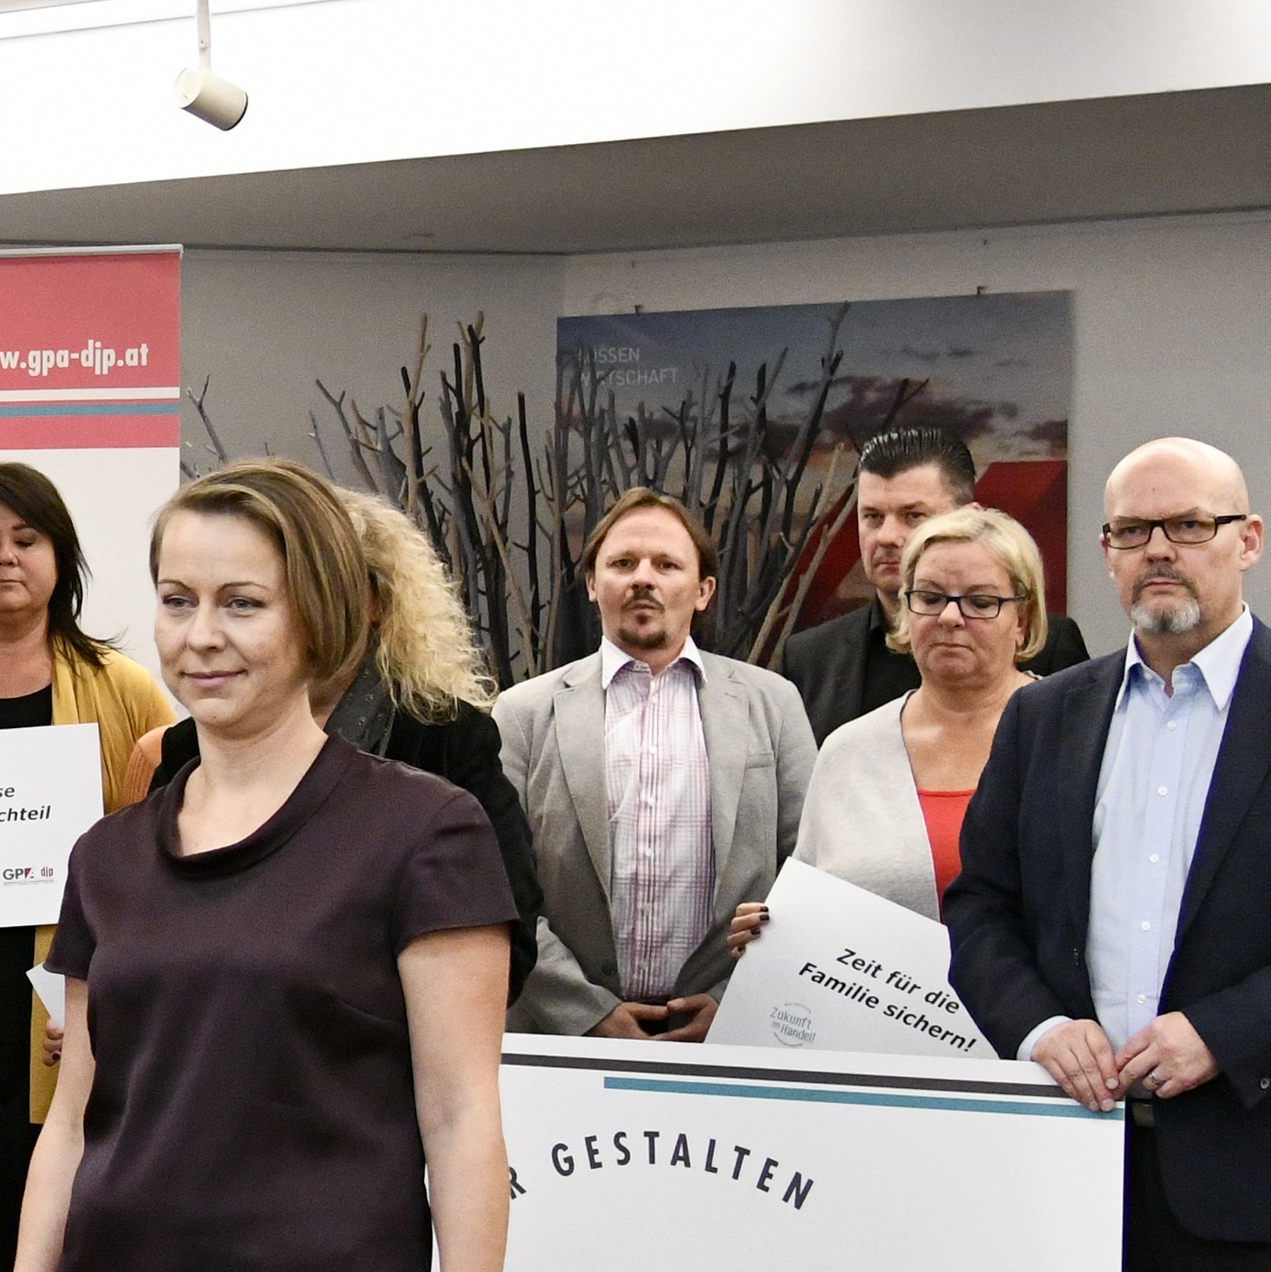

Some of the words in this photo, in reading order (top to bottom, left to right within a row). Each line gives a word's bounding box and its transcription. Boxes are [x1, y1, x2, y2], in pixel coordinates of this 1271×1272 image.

[798, 962, 879, 1009] Familie
[883, 1002, 977, 1052] sichern!
[836, 948, 883, 979] Zeit
[885, 970, 921, 995] für
[924, 989, 960, 1014] die
[551, 1131, 814, 1210] GESTALTEN
